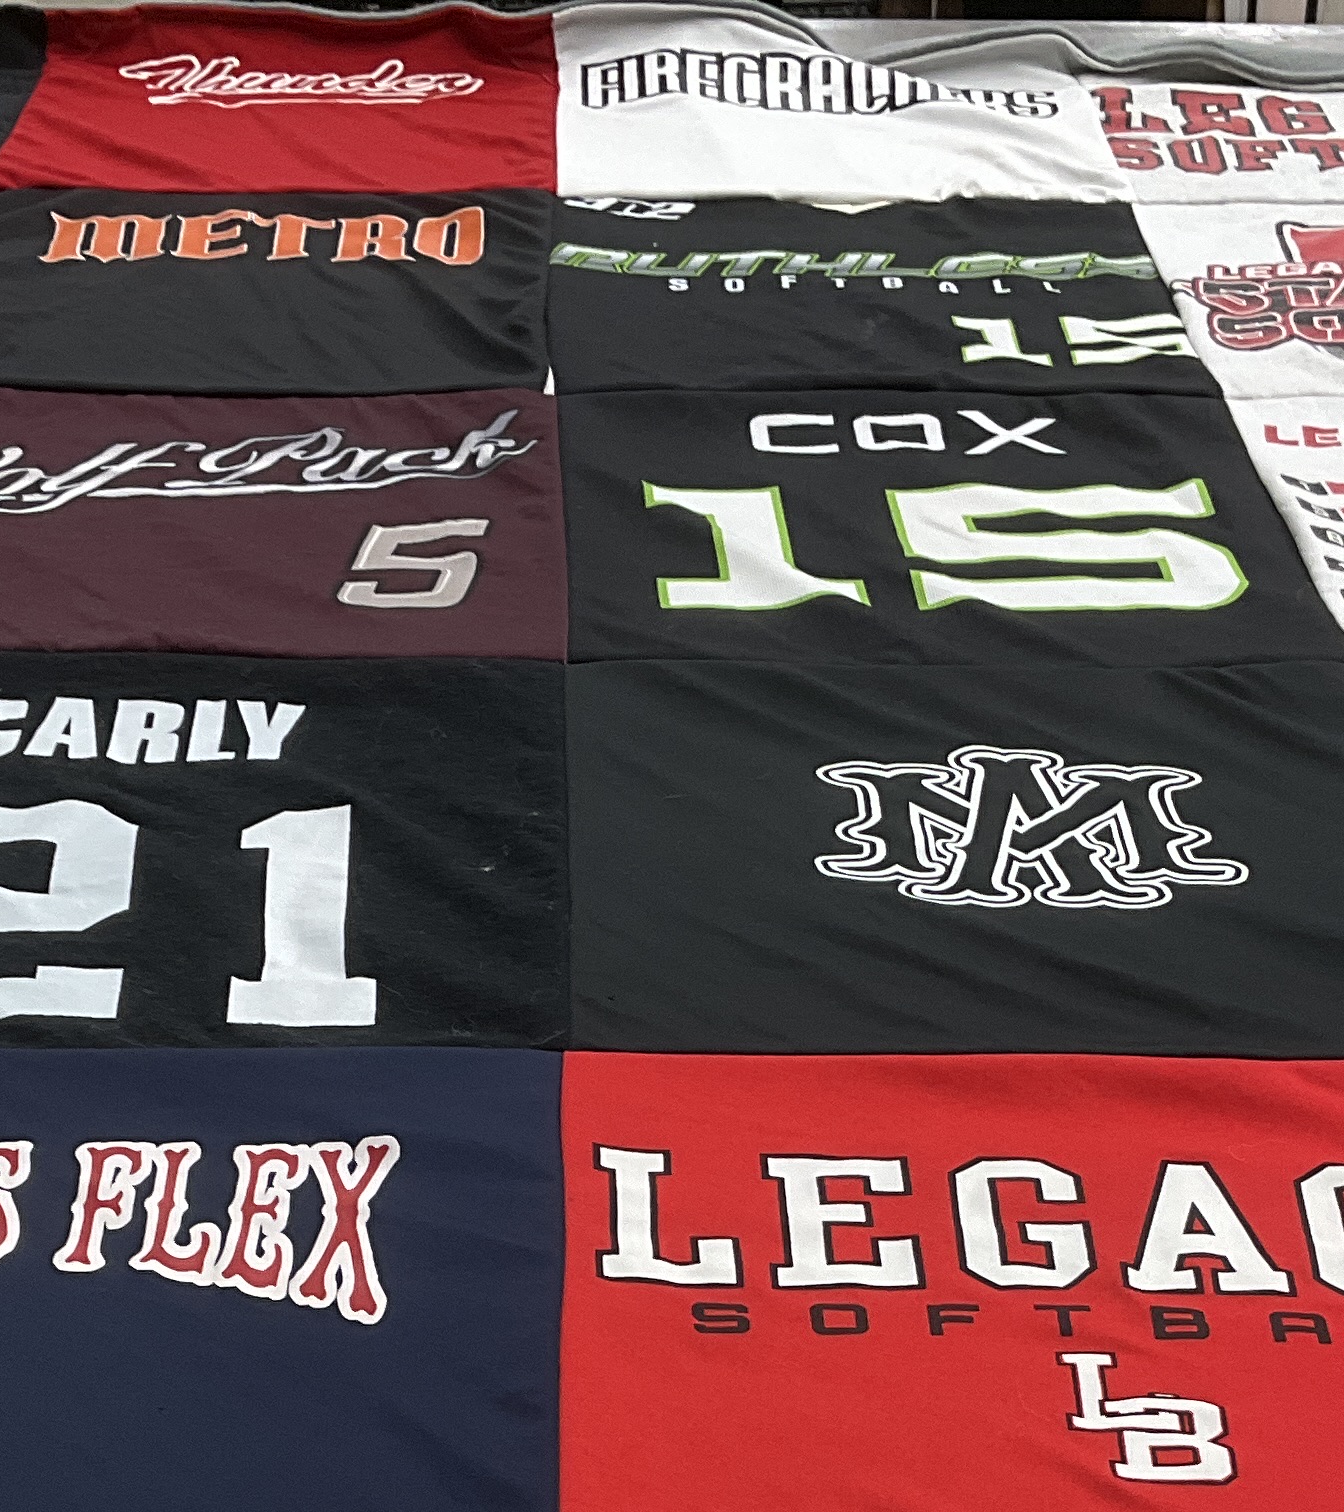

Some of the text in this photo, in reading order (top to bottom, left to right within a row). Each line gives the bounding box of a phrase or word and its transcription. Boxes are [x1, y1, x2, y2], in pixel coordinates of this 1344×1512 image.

[119, 54, 484, 100] Thunder
[39, 205, 485, 265] METRO
[667, 274, 1061, 294] SOFTBALL
[952, 313, 1201, 367] 15
[199, 409, 538, 485] Pack
[748, 410, 1067, 457] COX
[336, 518, 489, 608] 5
[642, 478, 1249, 611] 15
[53, 1134, 401, 1326] FLEX
[1056, 1348, 1238, 1485] LB
